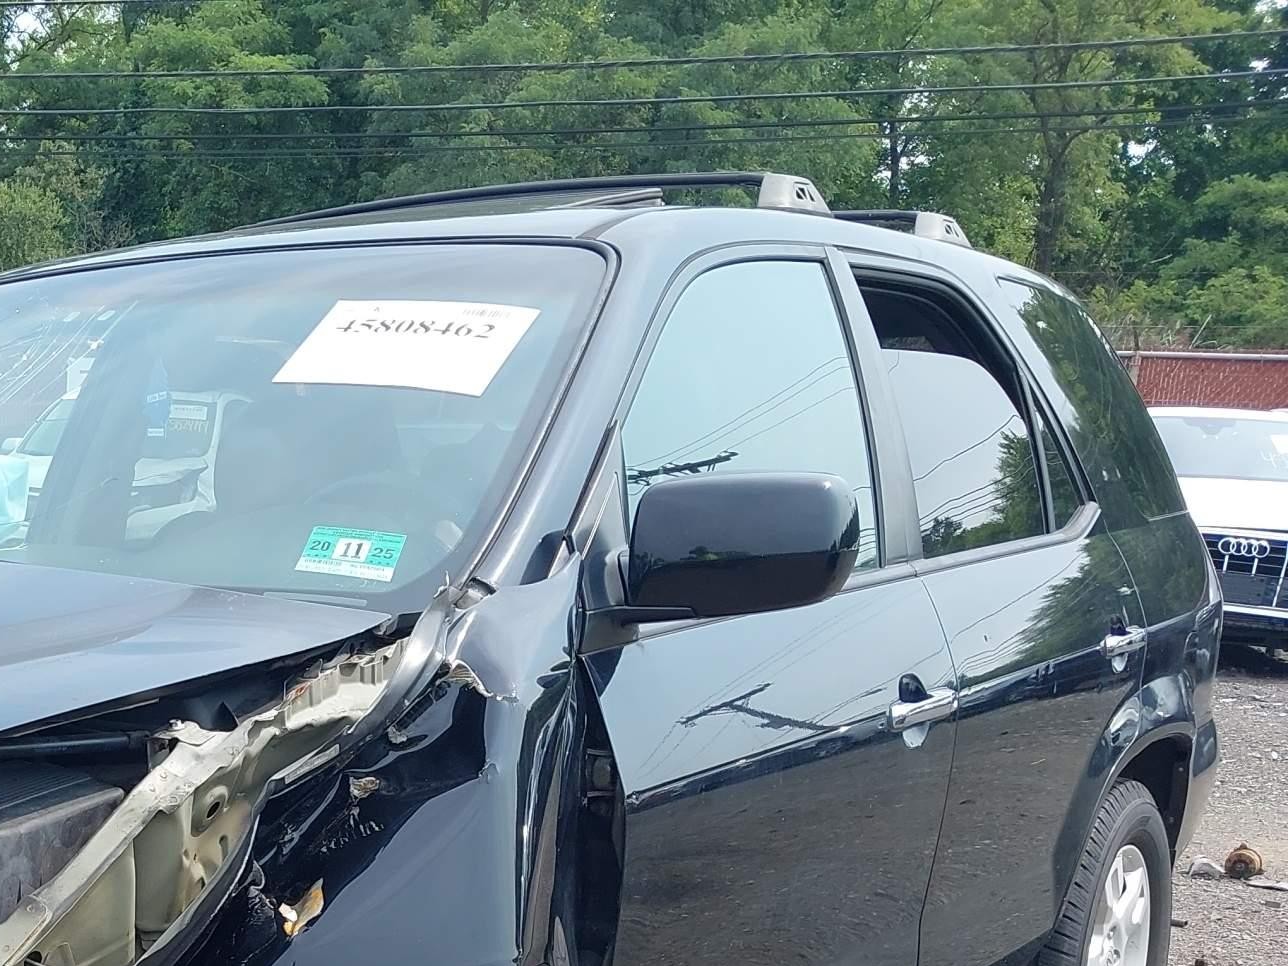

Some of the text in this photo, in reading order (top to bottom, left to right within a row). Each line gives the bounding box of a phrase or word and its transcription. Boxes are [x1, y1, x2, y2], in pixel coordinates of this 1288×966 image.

[336, 318, 496, 339] 45808462
[310, 540, 396, 559] 20 11 25
